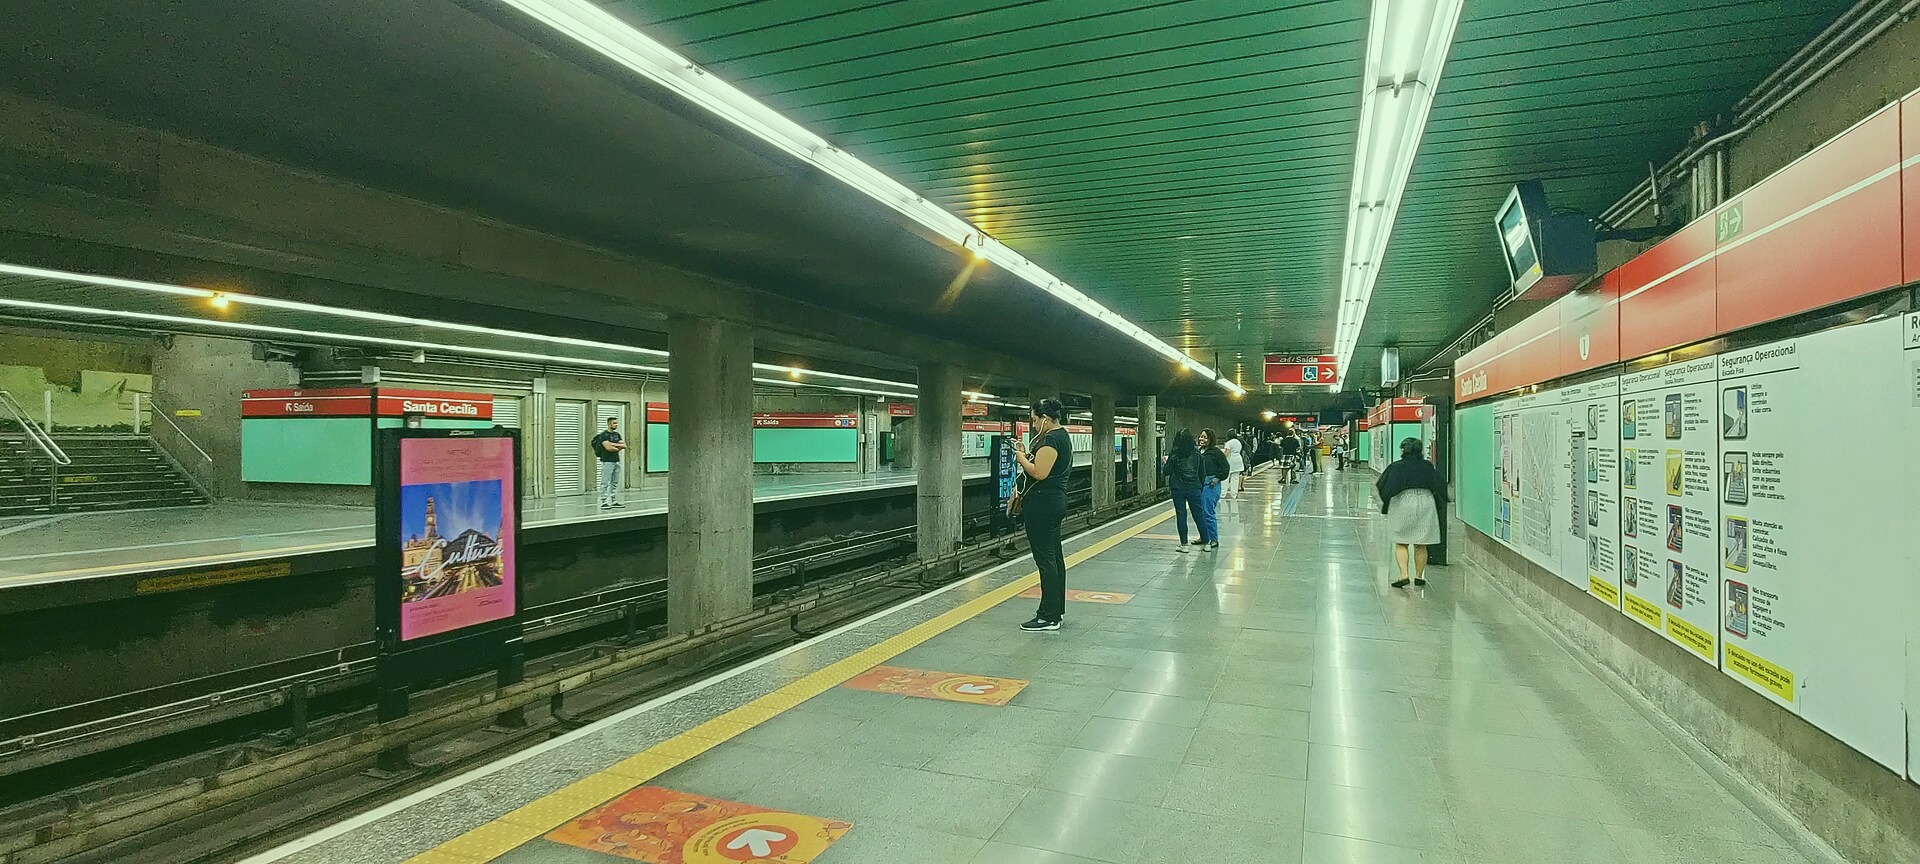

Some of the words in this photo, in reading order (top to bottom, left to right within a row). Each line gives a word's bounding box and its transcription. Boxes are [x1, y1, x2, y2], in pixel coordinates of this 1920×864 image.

[1722, 354, 1753, 368] Segurança
[1754, 343, 1796, 362] Operacional
[1664, 366, 1686, 378] Segurança
[1687, 360, 1714, 374] Operacional
[1461, 376, 1472, 397] Santa
[1473, 370, 1488, 393] Cecília
[403, 400, 436, 413] Santa
[440, 402, 478, 415] Cecília
[402, 534, 504, 580] Cultura
